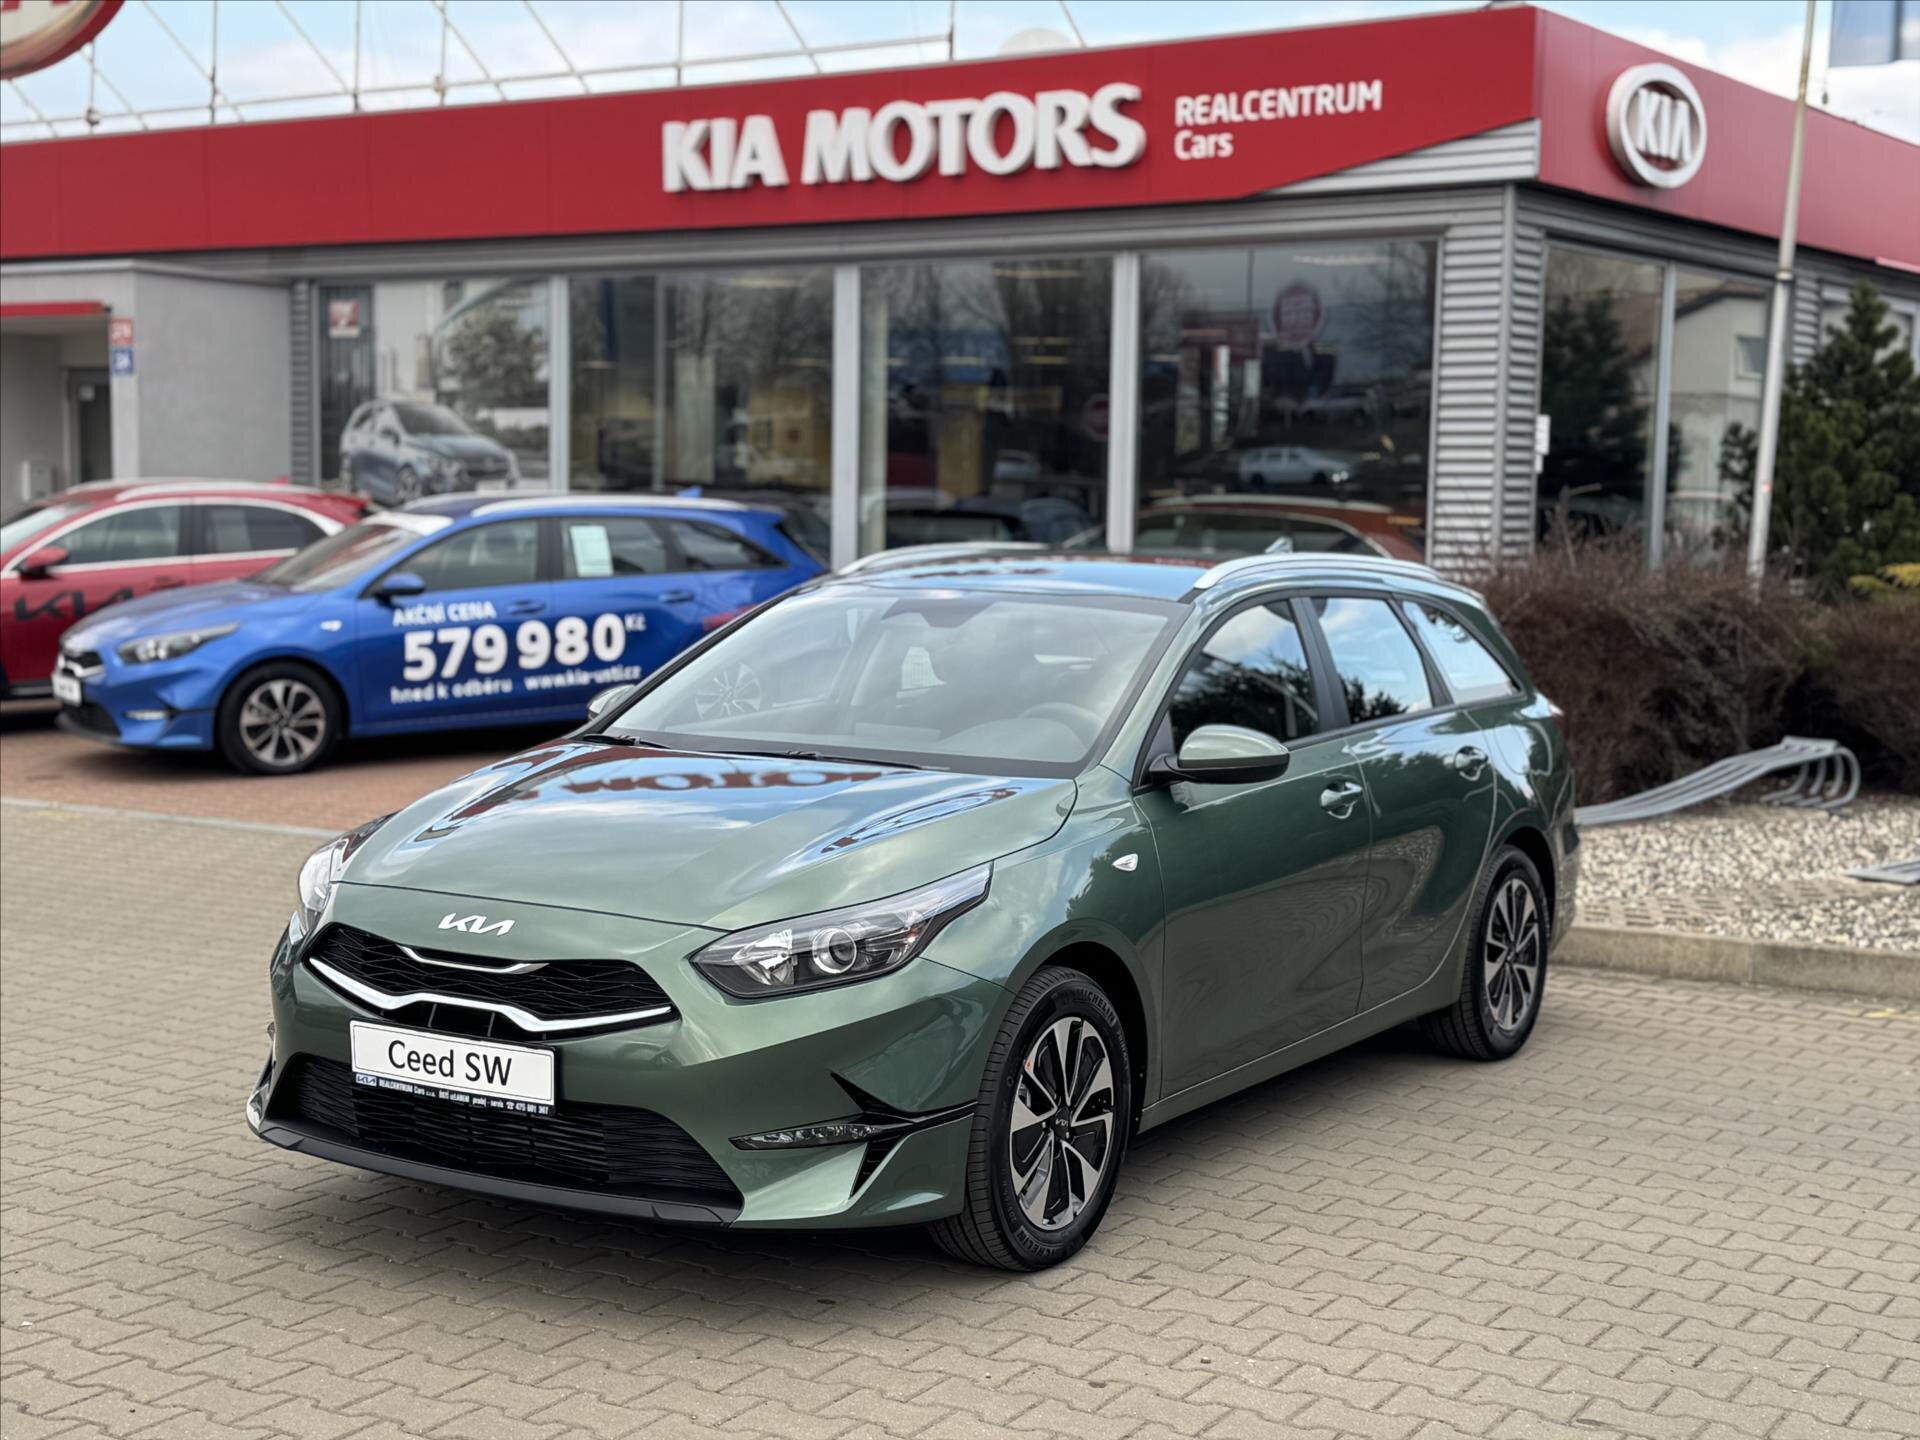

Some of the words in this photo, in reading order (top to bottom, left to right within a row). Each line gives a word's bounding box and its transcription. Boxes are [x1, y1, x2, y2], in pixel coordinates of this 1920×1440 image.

[1174, 79, 1383, 127] REALCENTRUM
[1636, 86, 1692, 162] KIA
[662, 114, 790, 193] KIA
[800, 82, 1147, 185] MOTORS
[1174, 129, 1235, 161] Cars
[447, 600, 497, 622] CENA
[403, 624, 508, 682] 579
[515, 613, 626, 670] 980
[438, 912, 516, 936] KIA
[388, 1039, 455, 1079] Ceed
[465, 1051, 513, 1086] SW
